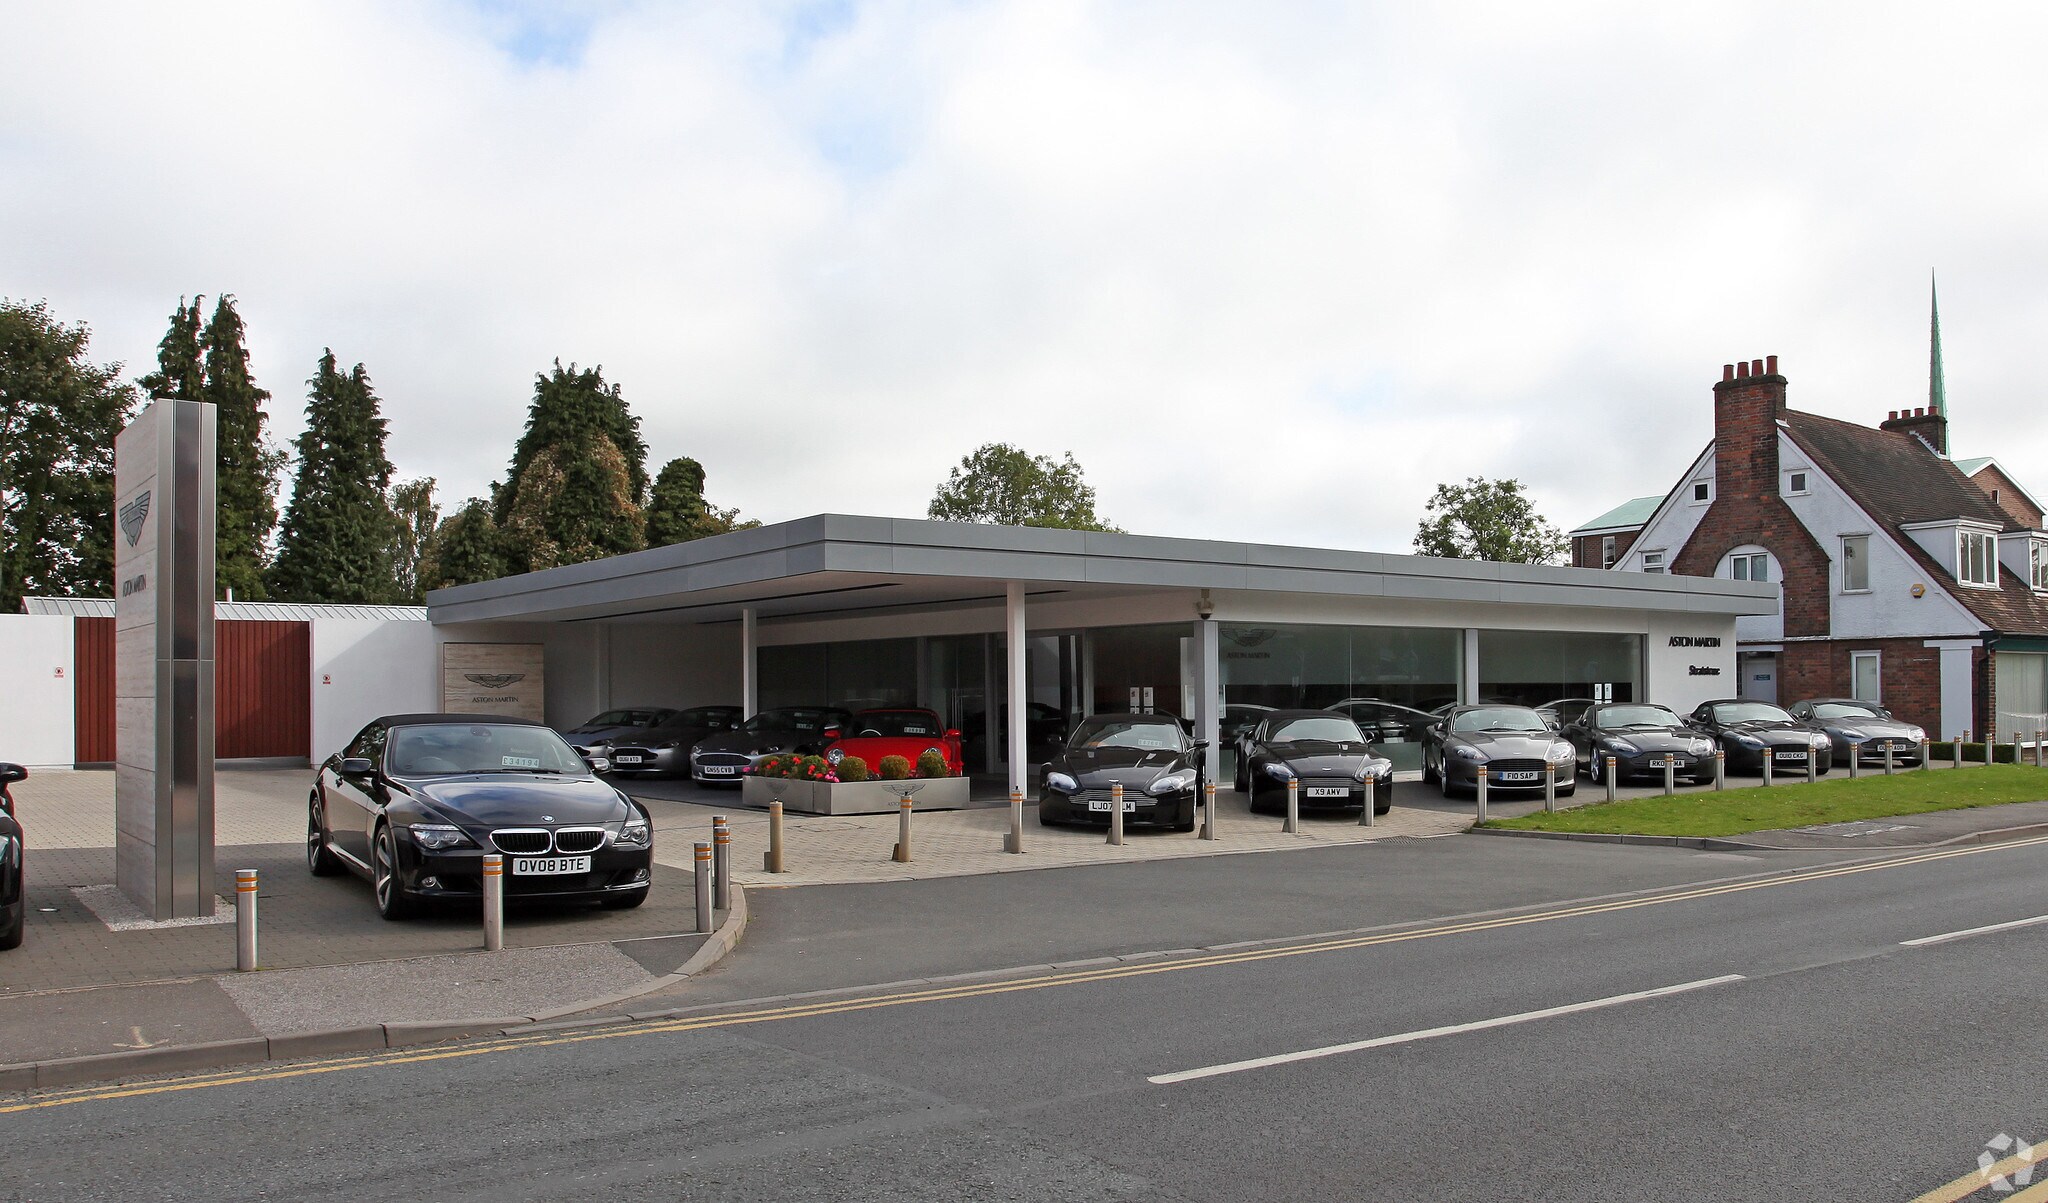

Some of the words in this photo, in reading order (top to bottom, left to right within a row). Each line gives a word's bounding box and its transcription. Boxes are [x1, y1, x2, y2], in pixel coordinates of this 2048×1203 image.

[1668, 636, 1693, 647] ASTON
[1694, 637, 1720, 648] MARTIN
[503, 757, 538, 766] £34194
[520, 860, 556, 872] OV08
[559, 858, 585, 871] BTE
